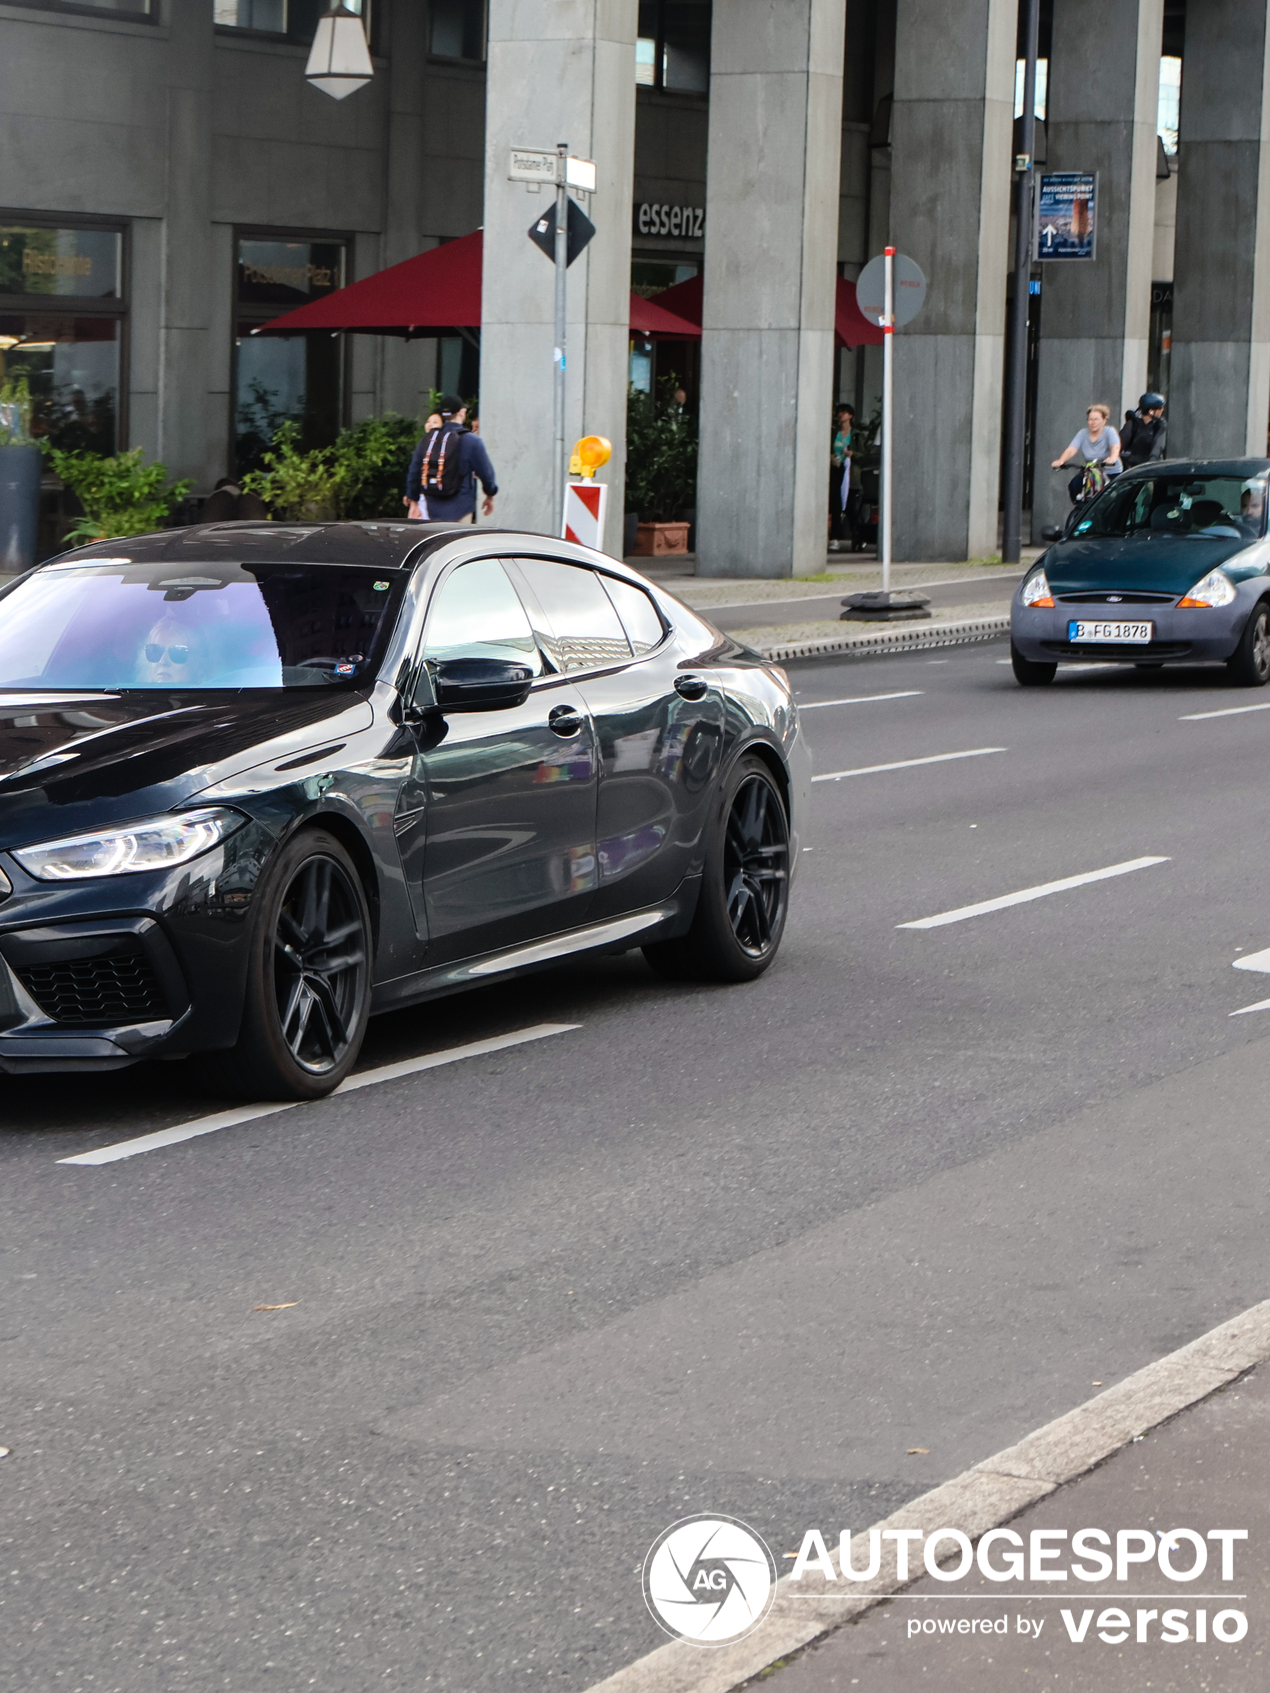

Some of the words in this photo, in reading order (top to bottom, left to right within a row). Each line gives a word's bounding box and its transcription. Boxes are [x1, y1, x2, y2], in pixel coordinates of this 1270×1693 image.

[513, 154, 541, 171] Potsdamer
[1042, 184, 1093, 193] AUSSICHTSPUNKT
[639, 203, 706, 237] essenz
[1077, 624, 1085, 637] B
[1094, 624, 1111, 638] FG
[1114, 625, 1148, 638] 1878
